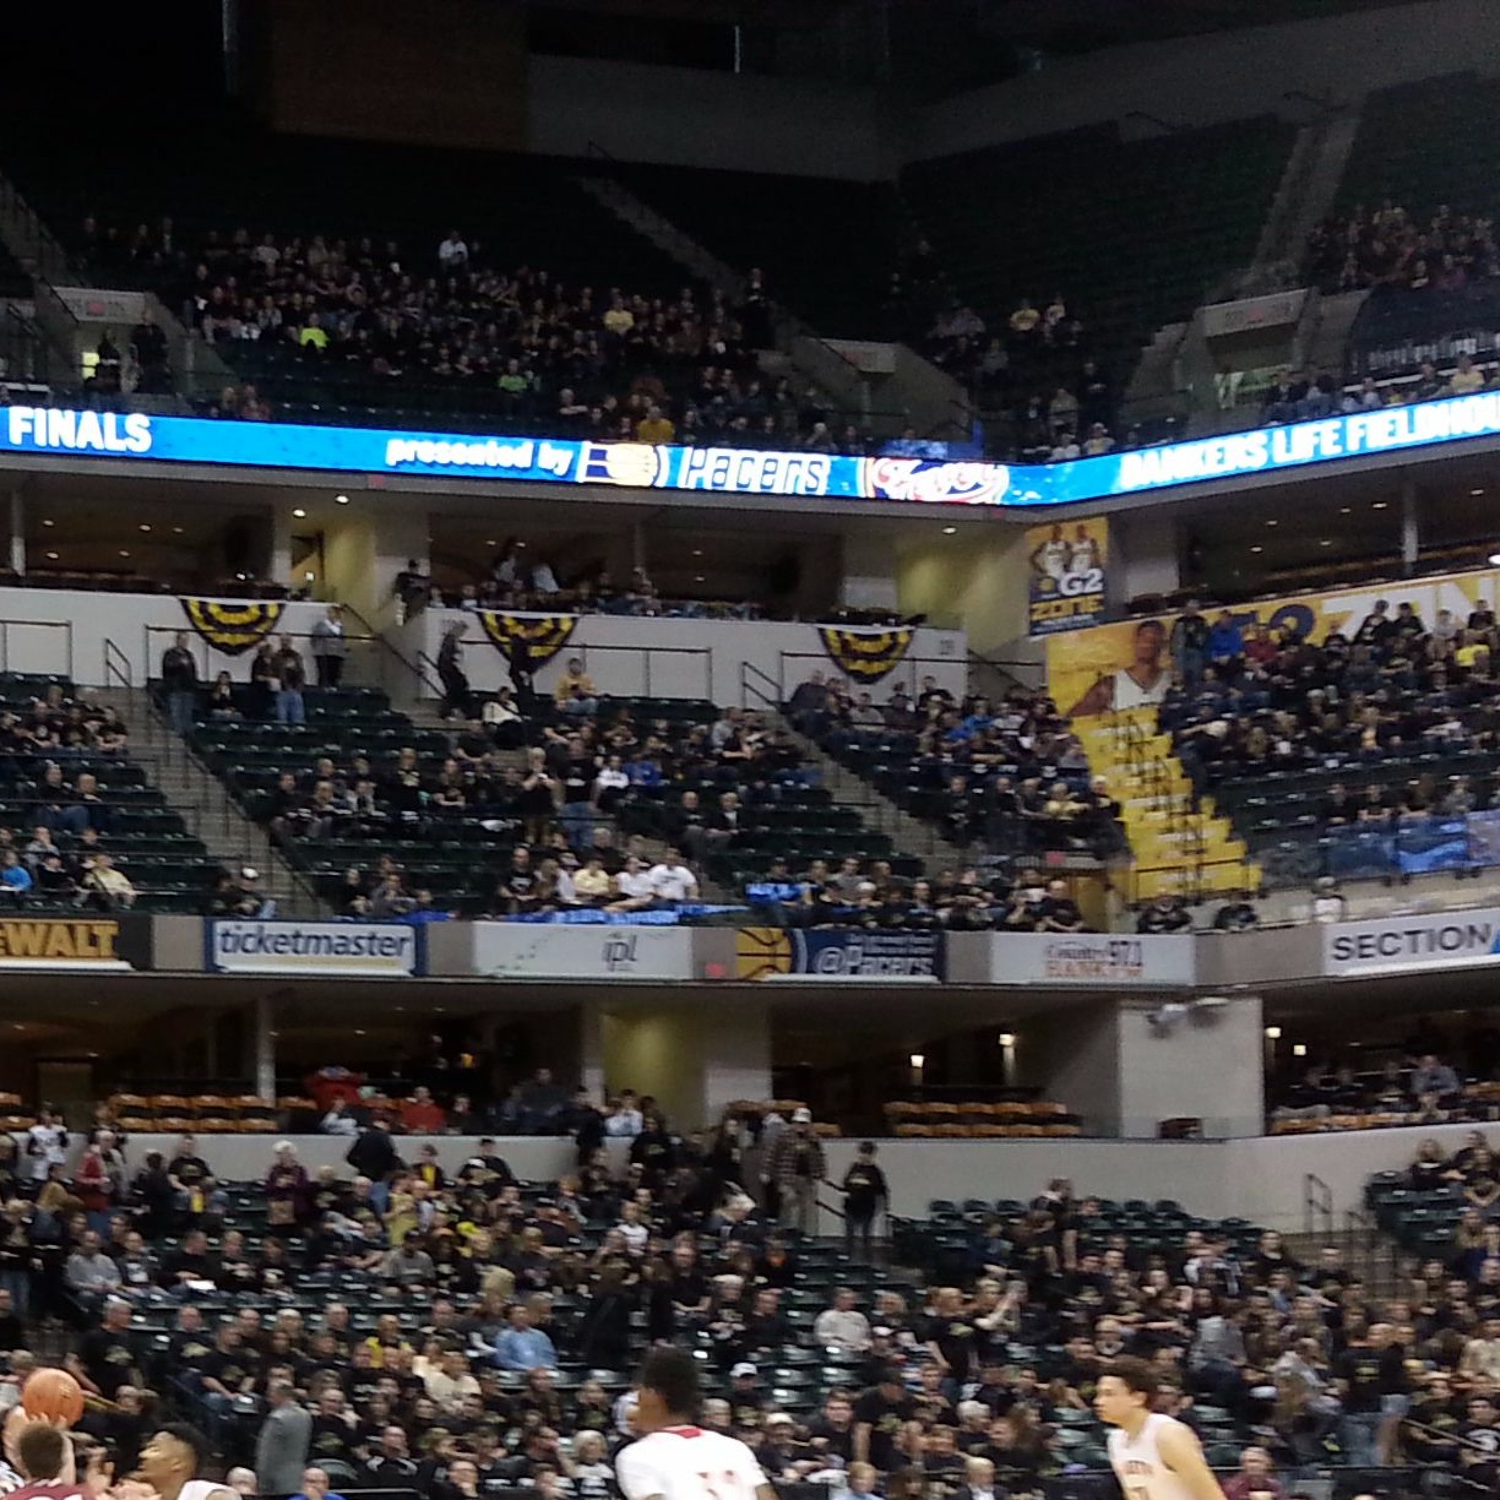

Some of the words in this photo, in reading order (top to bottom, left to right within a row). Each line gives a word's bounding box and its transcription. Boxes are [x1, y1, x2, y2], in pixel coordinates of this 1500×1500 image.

[8, 406, 152, 452] FINALS
[386, 439, 534, 468] presented
[538, 440, 574, 476] by
[1120, 430, 1270, 487] BANKERS
[1272, 420, 1343, 464] LIFE
[1059, 568, 1104, 596] G2
[220, 925, 409, 958] ticketmaster
[1331, 923, 1492, 962] SECTION
